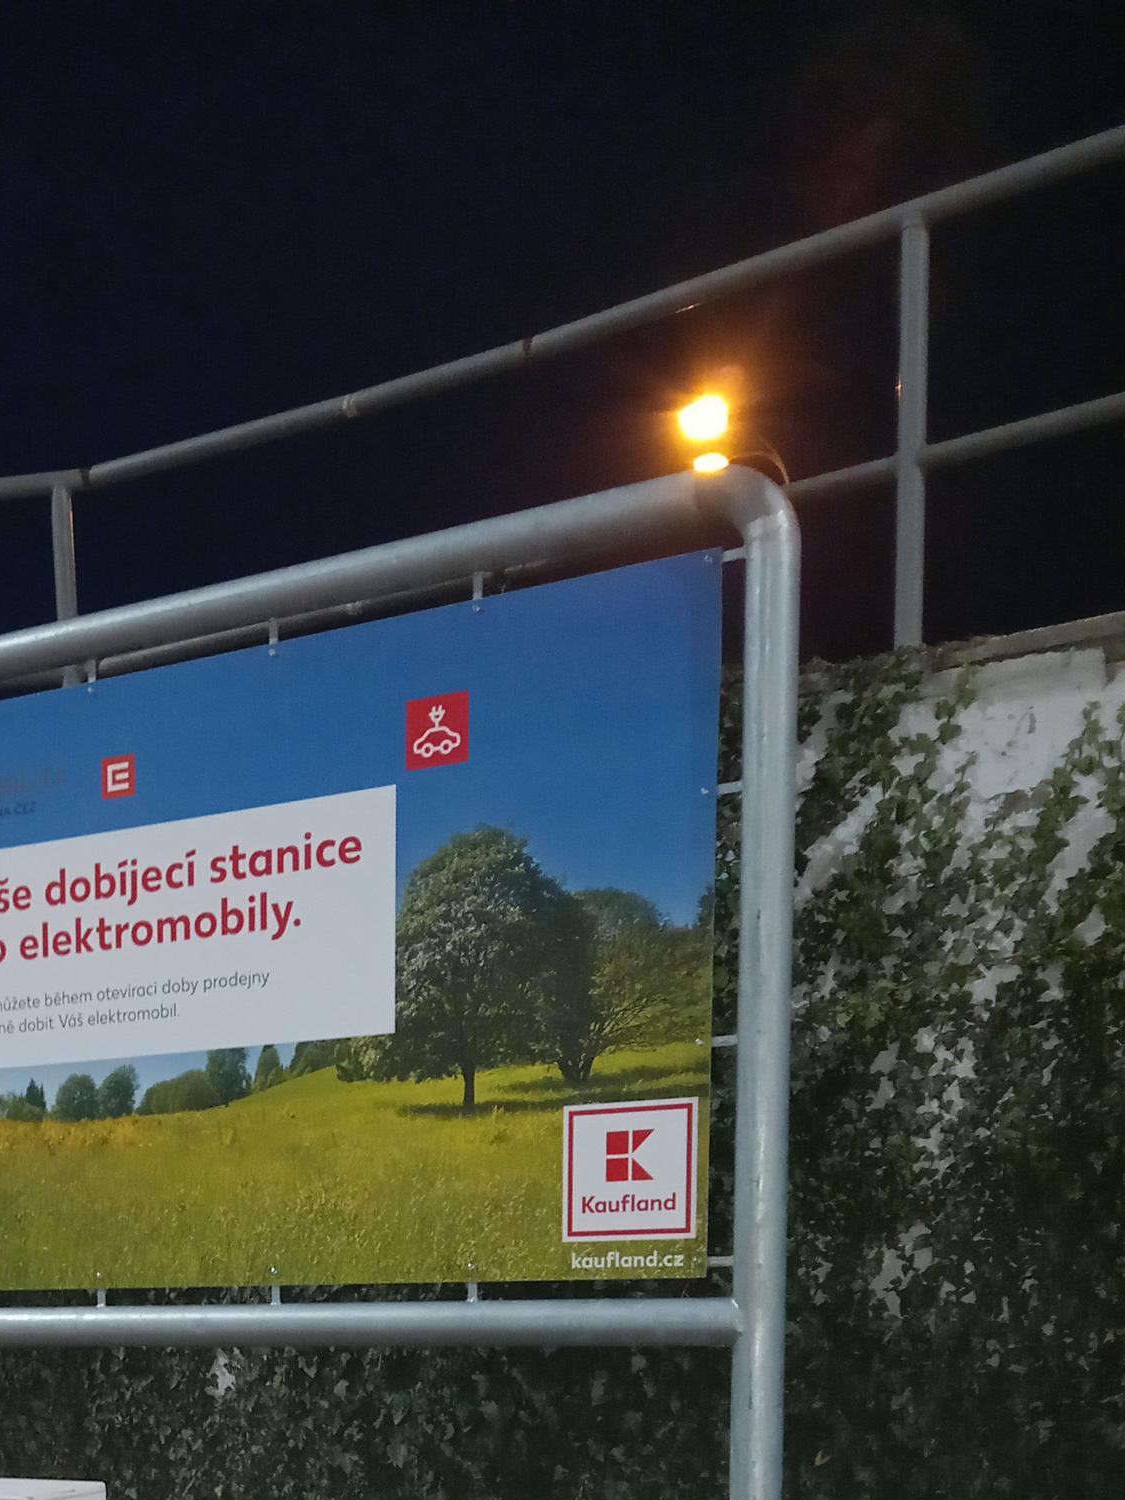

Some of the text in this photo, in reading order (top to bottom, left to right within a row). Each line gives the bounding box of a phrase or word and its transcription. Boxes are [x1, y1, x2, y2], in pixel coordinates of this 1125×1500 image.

[44, 850, 197, 908] dobíjecí
[210, 833, 362, 884] stanice
[19, 894, 302, 961] elektromobily.
[44, 989, 93, 1007] během
[162, 975, 199, 996] doby
[203, 971, 271, 991] prodejny
[58, 1013, 84, 1029] Váš
[582, 1193, 677, 1214] Kaufland
[571, 1251, 684, 1269] kaufland.cz
